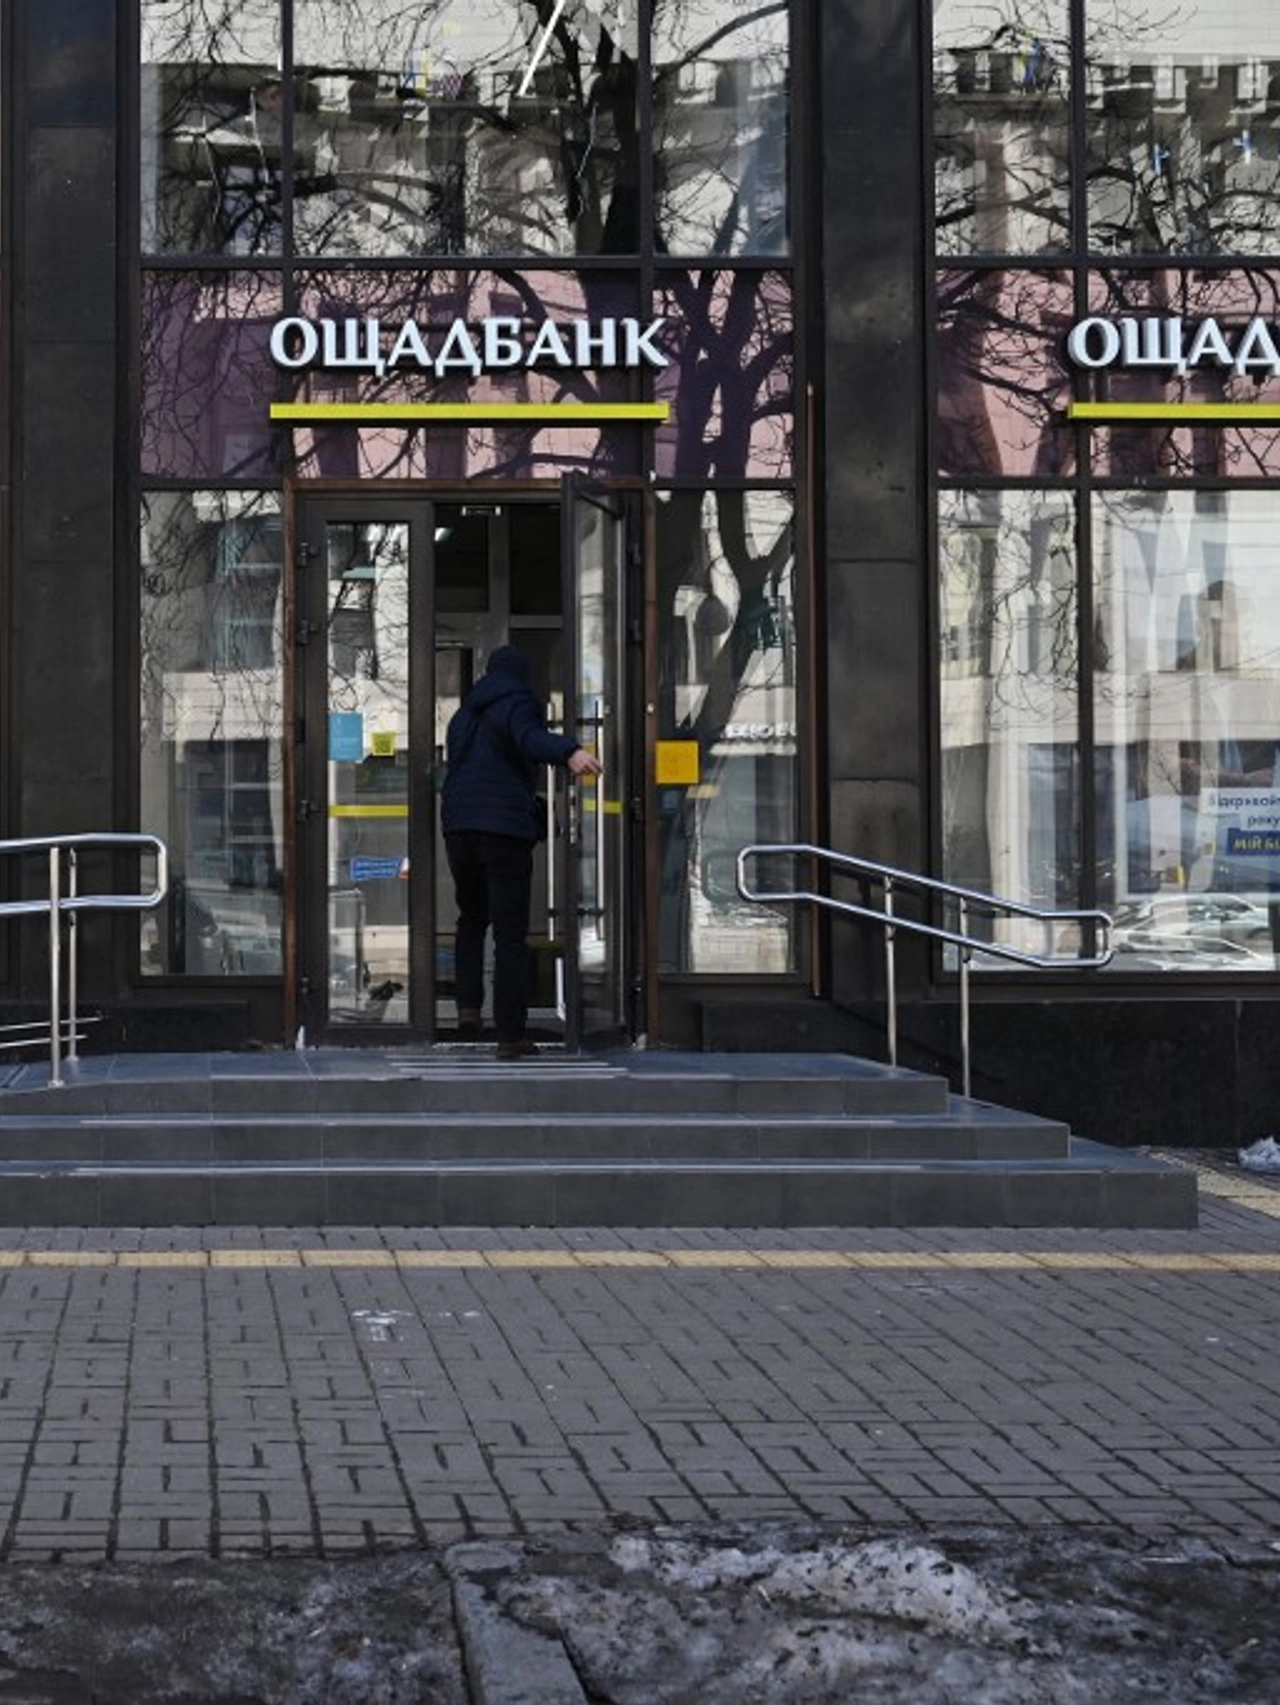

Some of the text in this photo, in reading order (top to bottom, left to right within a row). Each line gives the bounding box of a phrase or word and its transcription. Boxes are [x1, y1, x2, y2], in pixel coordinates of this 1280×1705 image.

[269, 316, 670, 378] ОЩАДБАНК
[1068, 316, 1280, 376] ОЩАД
[1208, 793, 1280, 810] Відкривай
